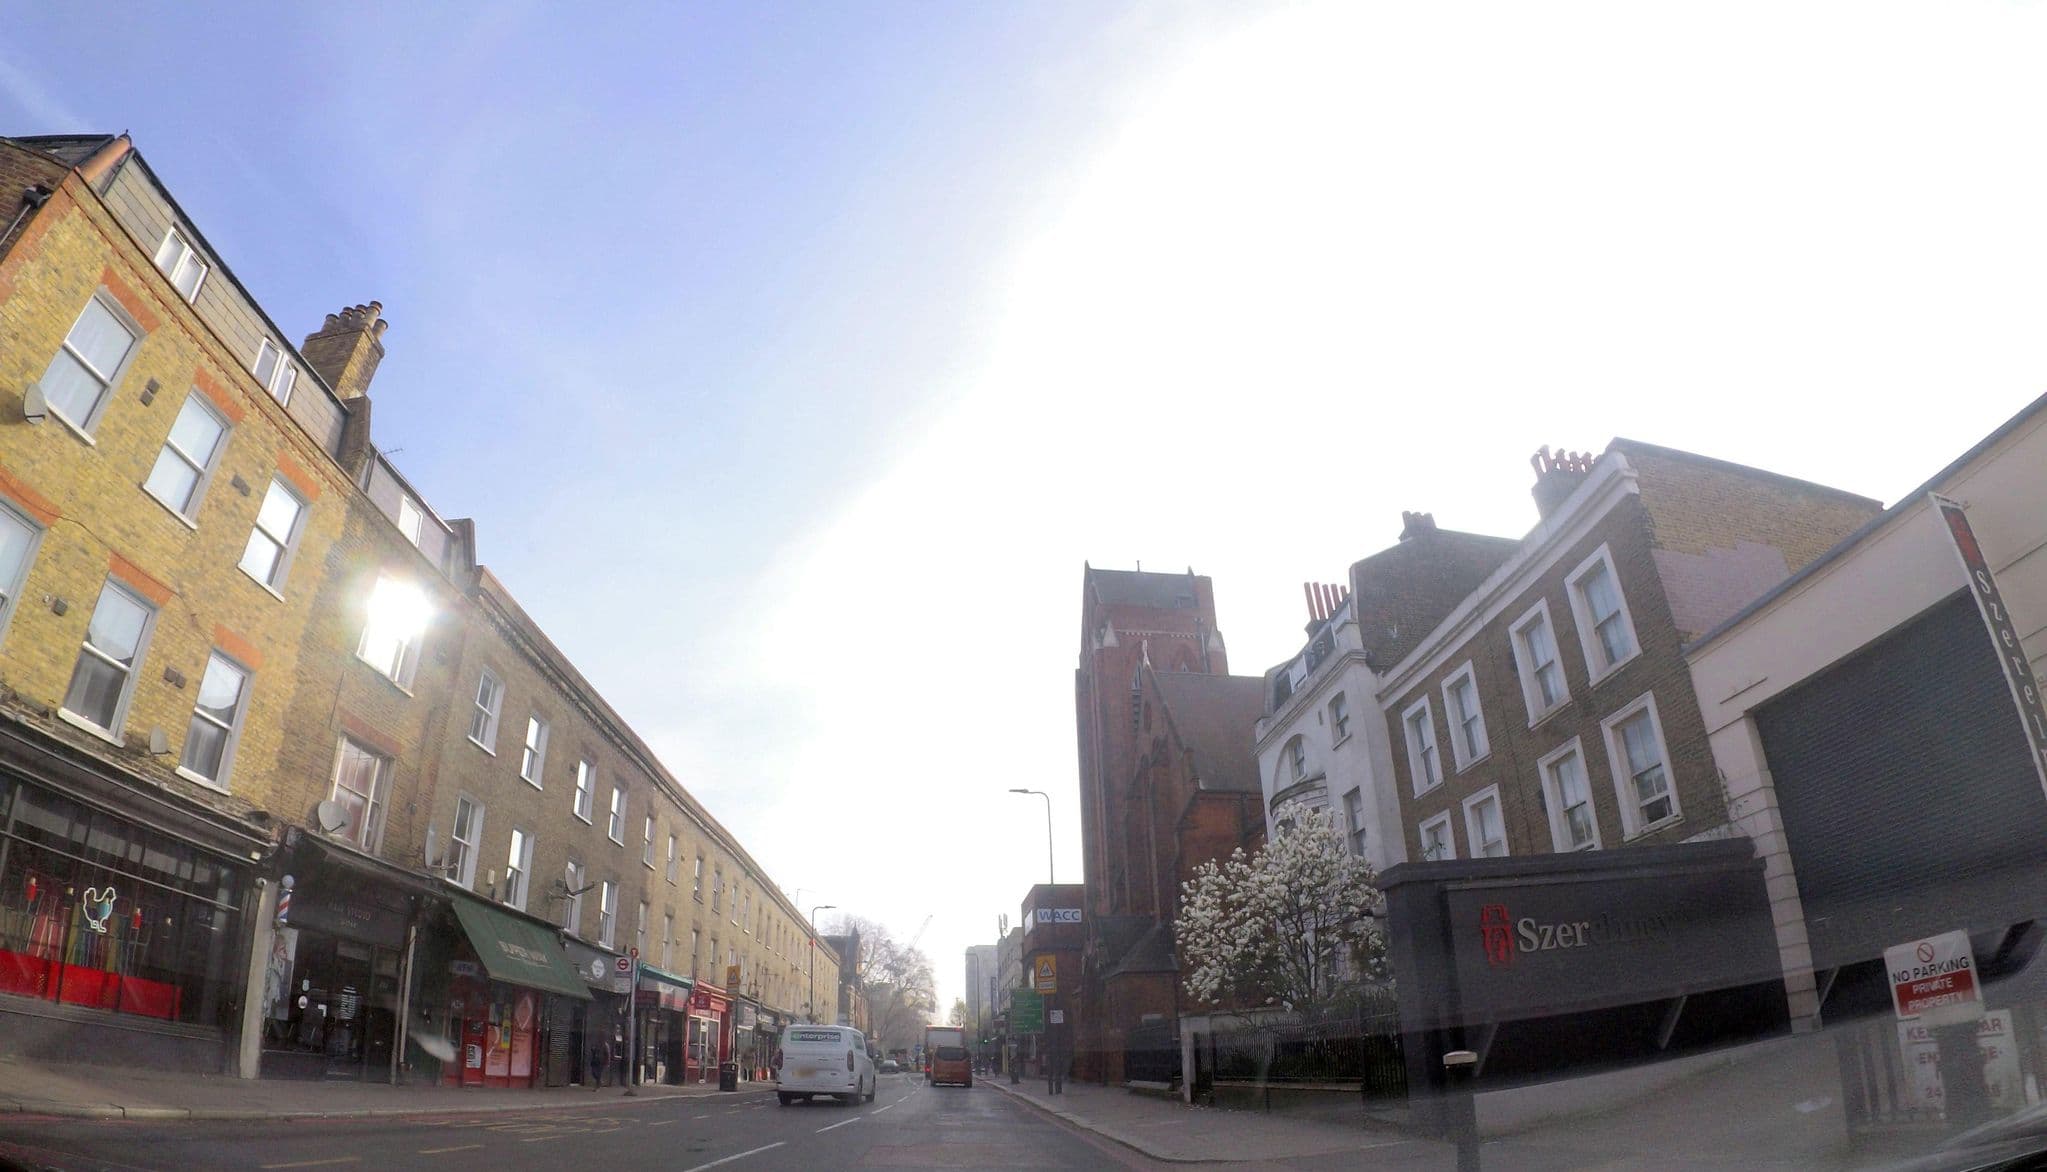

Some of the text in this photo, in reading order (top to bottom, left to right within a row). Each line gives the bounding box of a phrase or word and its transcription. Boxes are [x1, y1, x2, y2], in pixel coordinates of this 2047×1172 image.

[1039, 910, 1081, 921] WACC
[1892, 957, 1969, 982] NO PARKING
[1913, 978, 1953, 994] PRIVATE
[1909, 992, 1962, 1010] PROPERTY
[792, 1032, 840, 1041] enterprise
